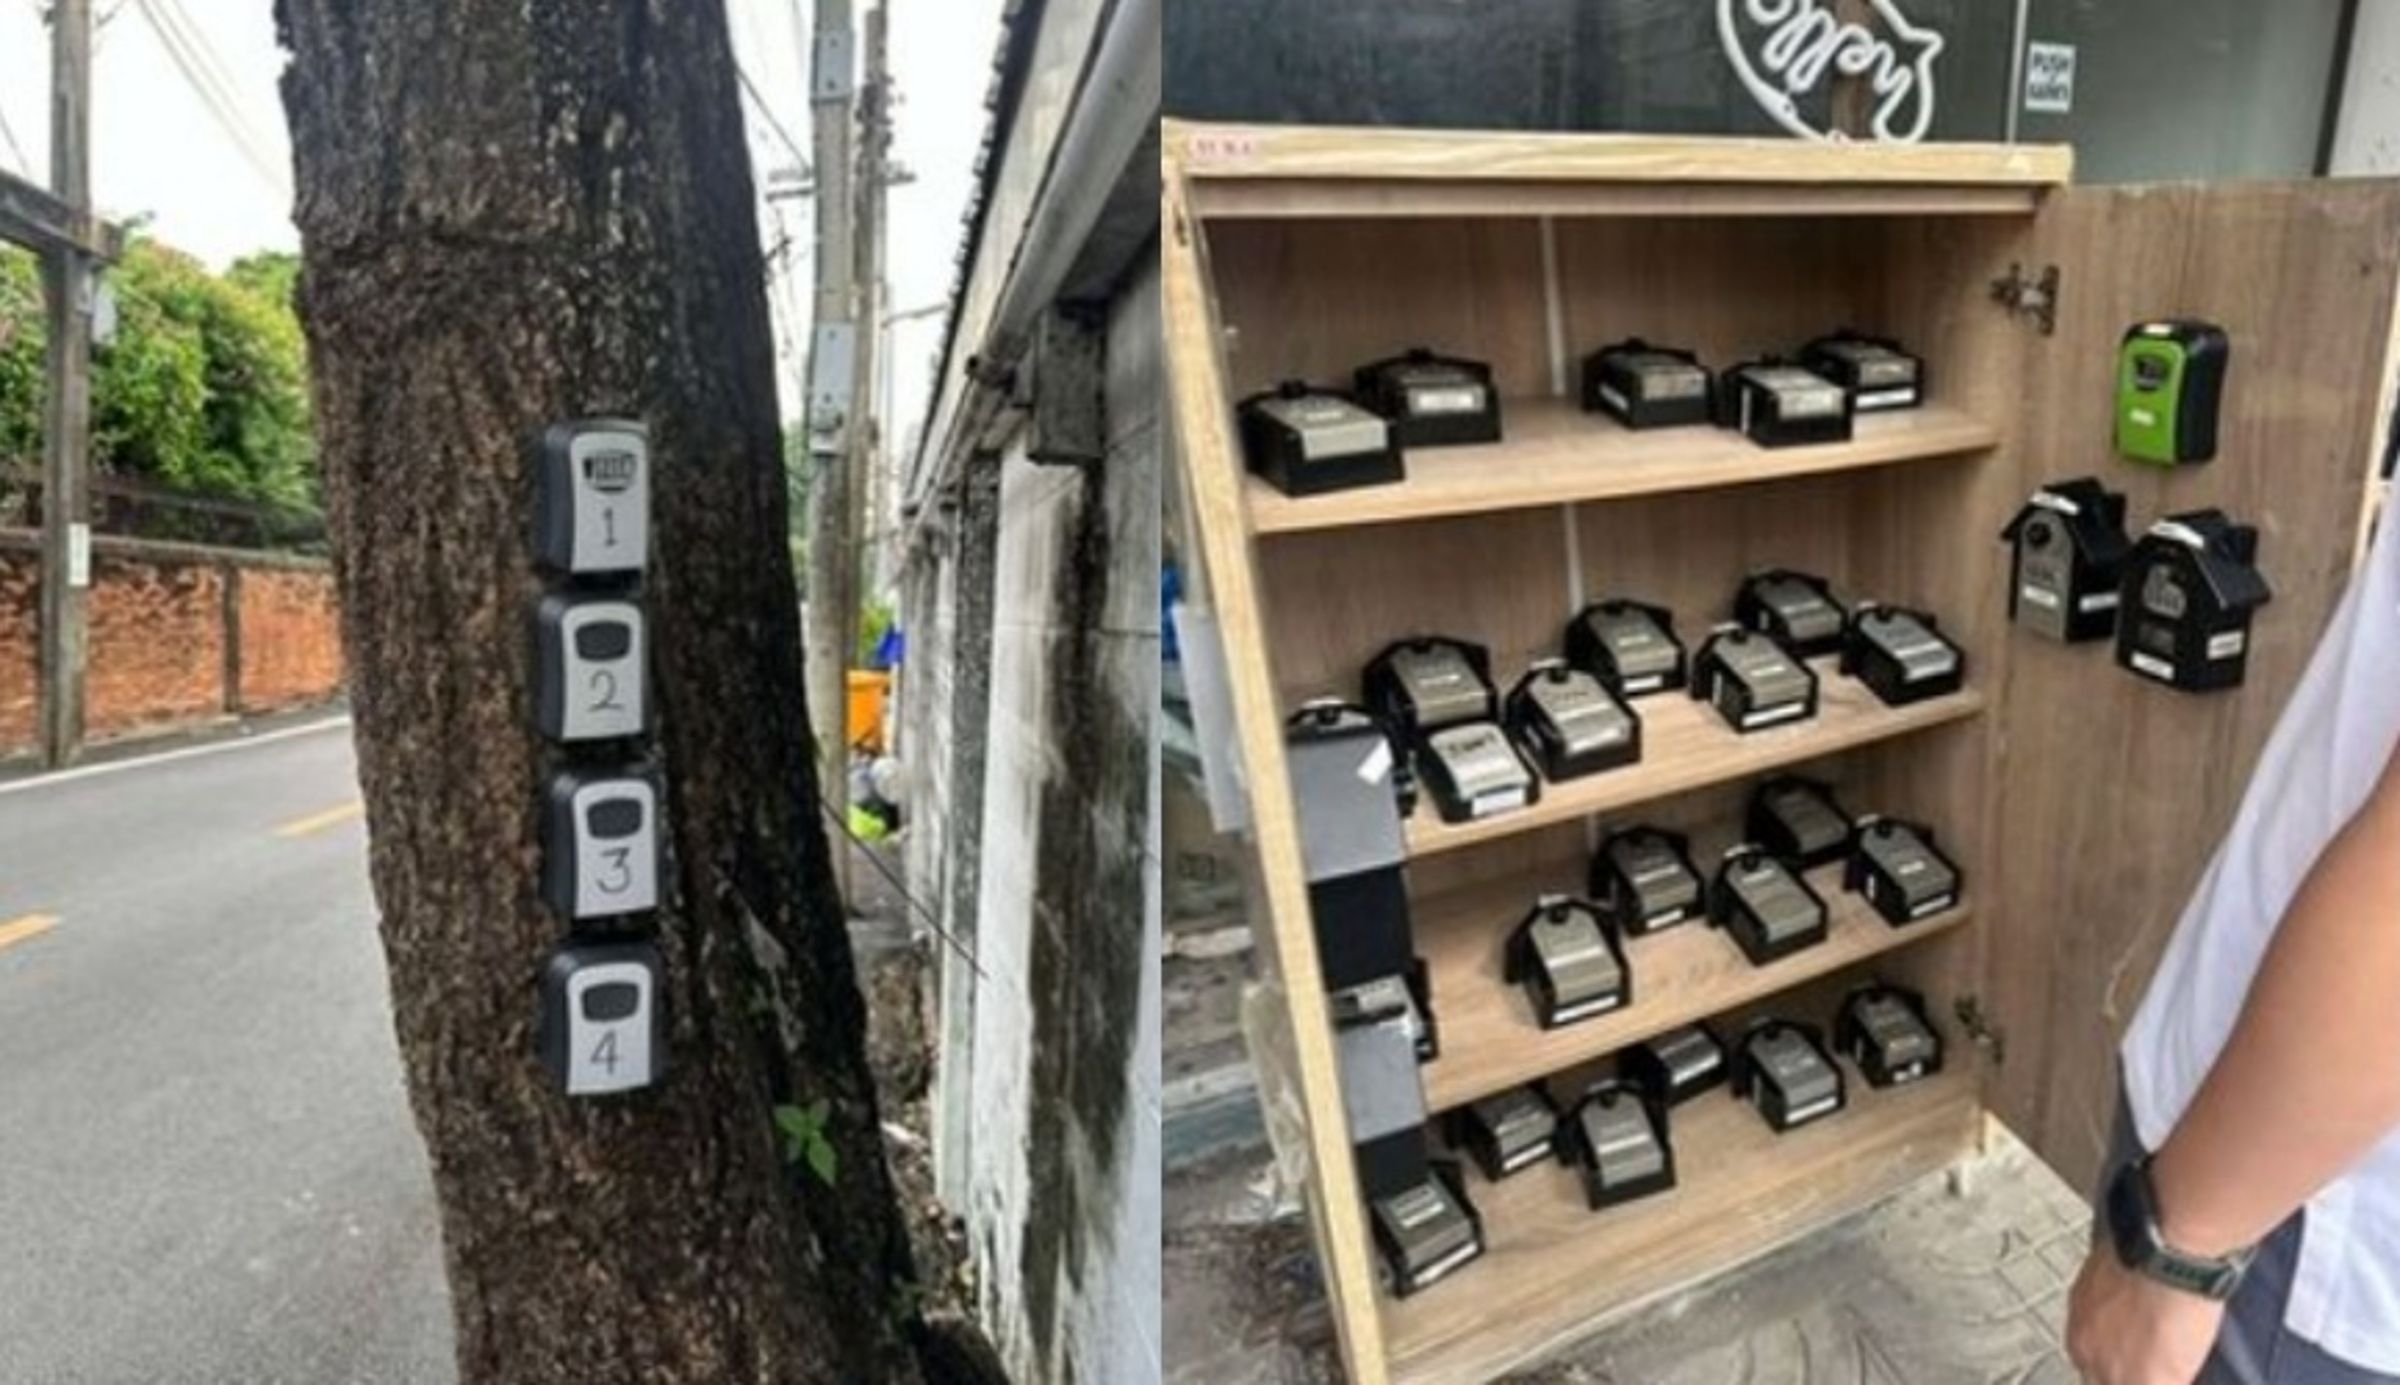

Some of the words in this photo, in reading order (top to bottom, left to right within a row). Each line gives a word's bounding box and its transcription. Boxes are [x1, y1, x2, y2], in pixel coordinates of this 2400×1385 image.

[603, 506, 618, 548] 1
[588, 668, 625, 712] 2
[597, 847, 632, 893] 3
[590, 1028, 624, 1076] 4
